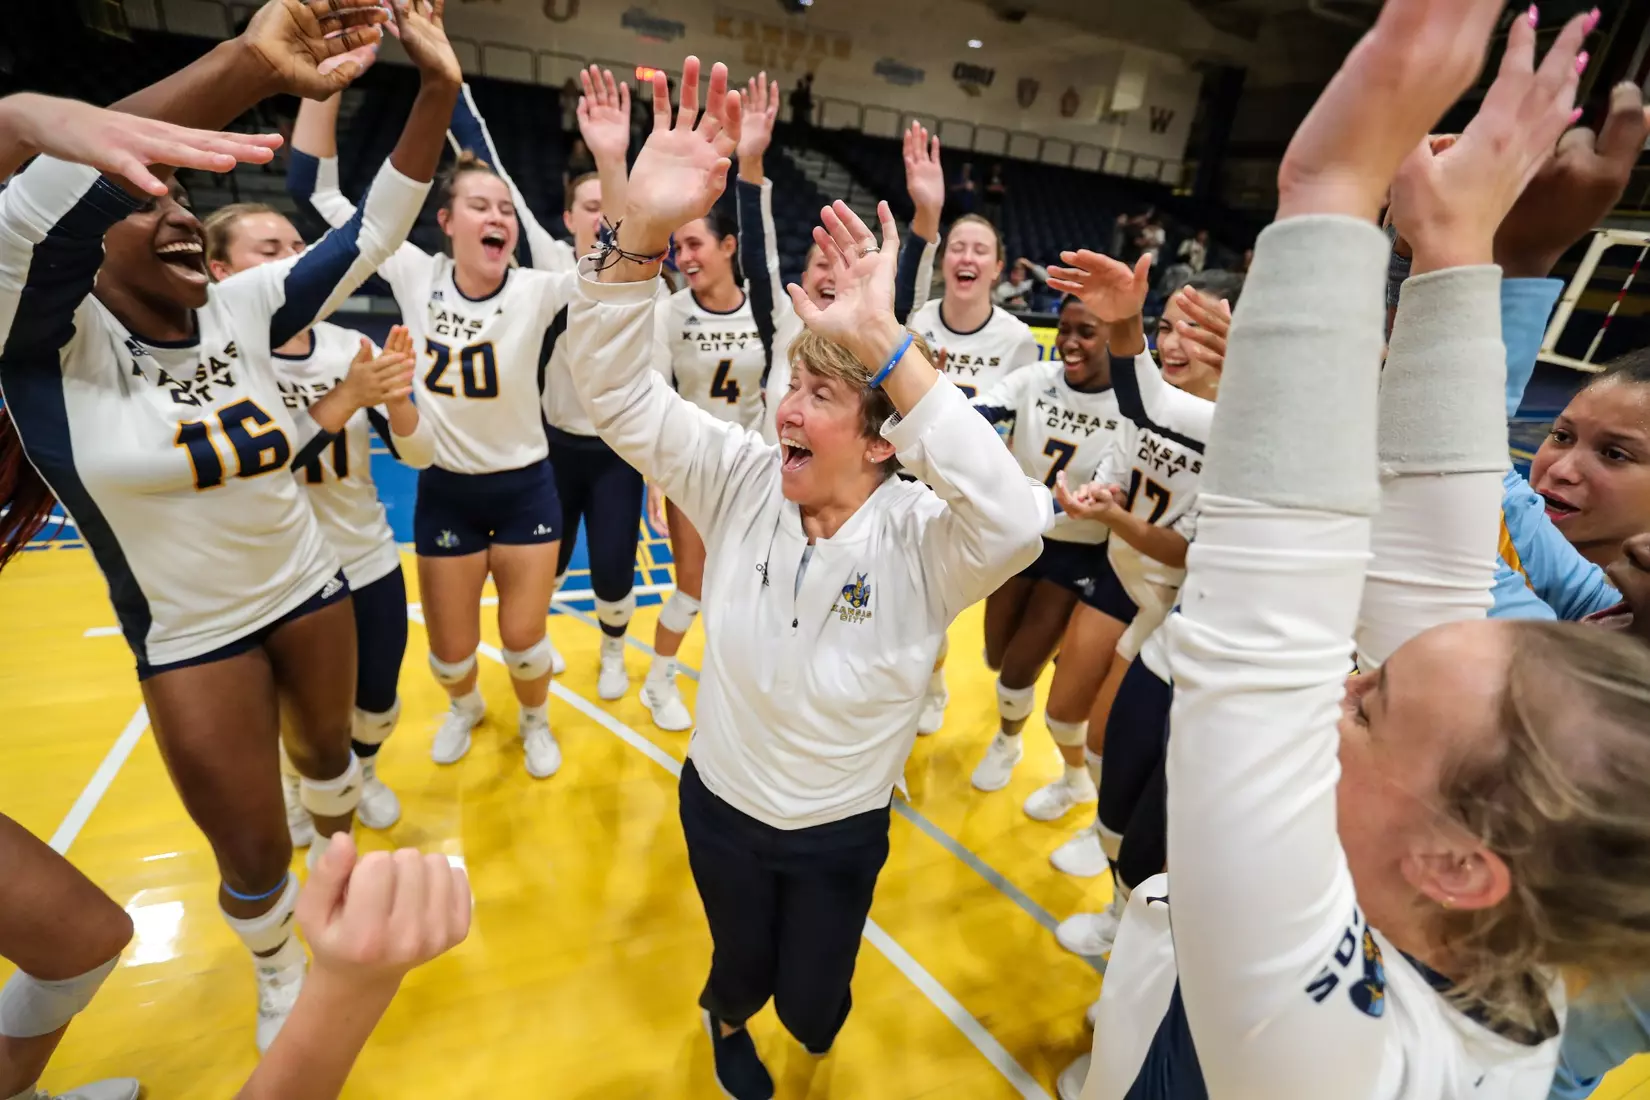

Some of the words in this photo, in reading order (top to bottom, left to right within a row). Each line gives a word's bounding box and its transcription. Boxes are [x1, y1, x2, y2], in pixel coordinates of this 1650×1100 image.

[436, 324, 477, 340] CIT
[682, 331, 760, 341] KANSAS
[700, 342, 746, 351] CITY
[424, 335, 500, 399] 20
[931, 349, 1001, 367] ANSAS
[946, 363, 980, 376] ITY
[709, 358, 741, 405] 4
[1036, 398, 1119, 431] KANSAS
[1046, 416, 1096, 438] CITY
[173, 396, 291, 493] 16
[1139, 432, 1204, 475] ANSAS
[1041, 436, 1079, 490] 7
[1125, 466, 1172, 524] 17
